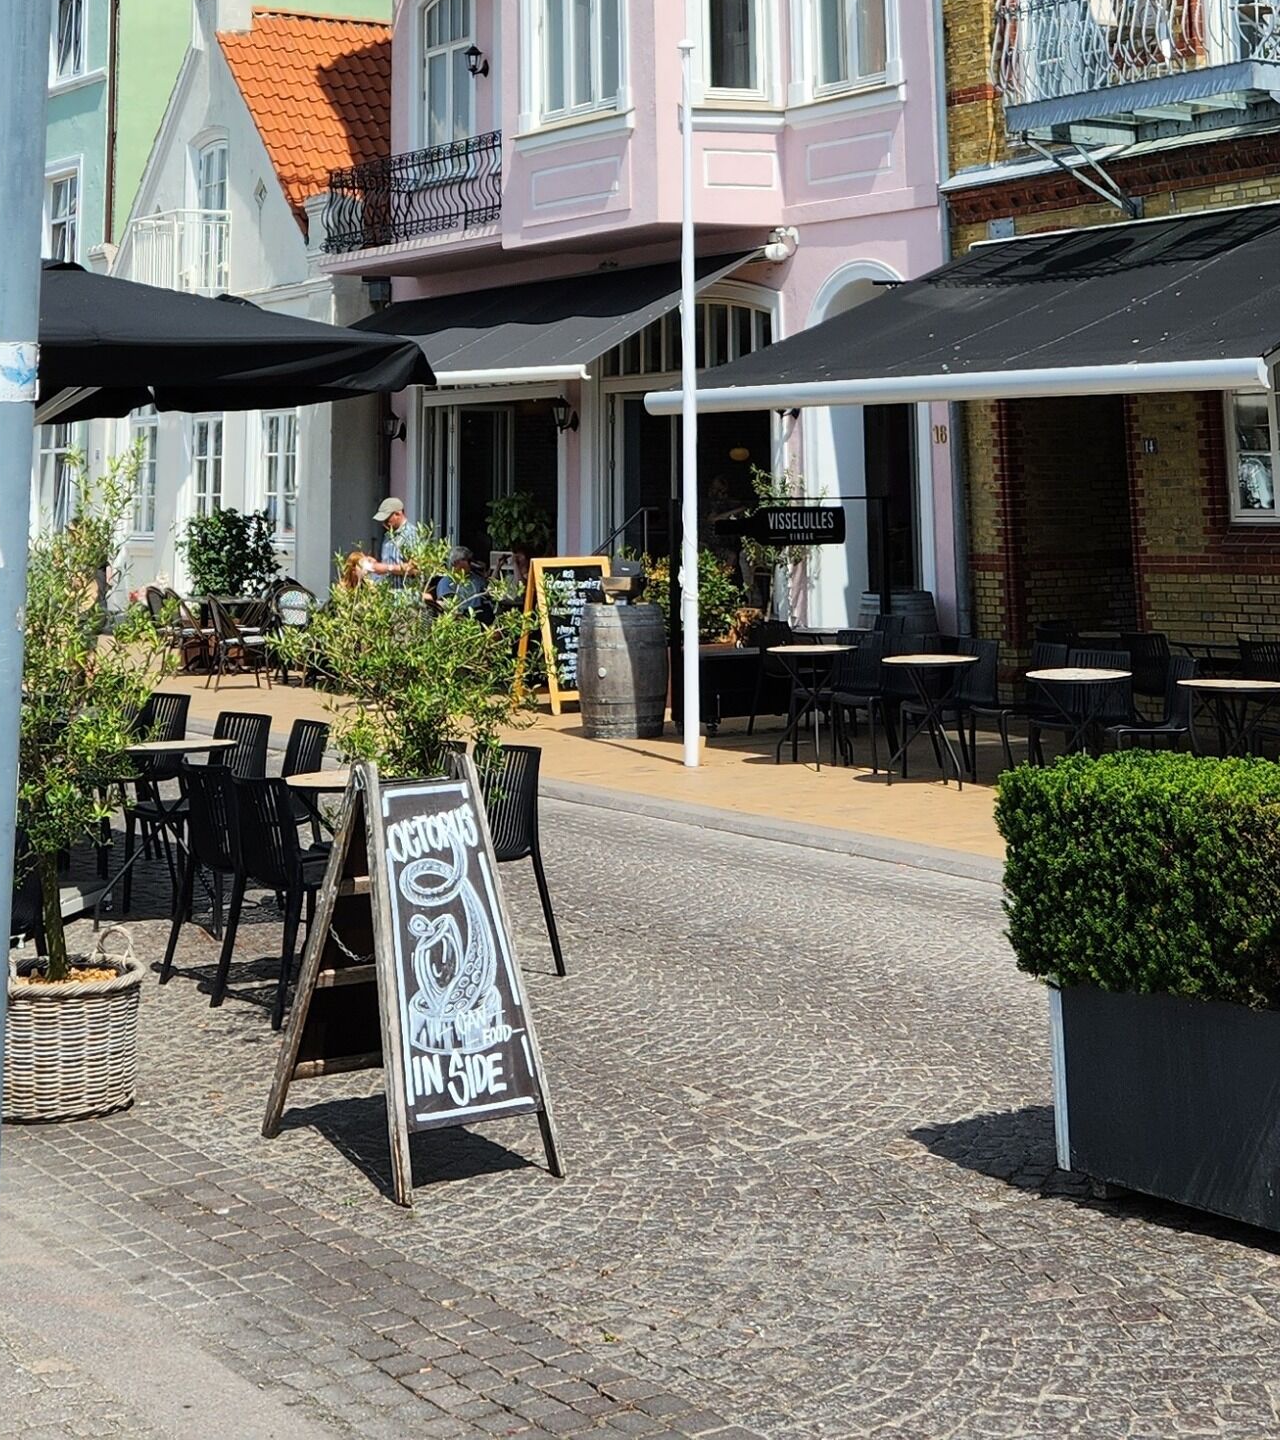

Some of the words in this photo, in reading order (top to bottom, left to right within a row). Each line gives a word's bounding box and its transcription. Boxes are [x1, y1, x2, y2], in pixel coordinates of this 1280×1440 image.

[933, 425, 947, 444] 18
[768, 512, 834, 530] VISSELULLES
[387, 803, 479, 863] OCTOPUS
[483, 1024, 513, 1044] FOOD
